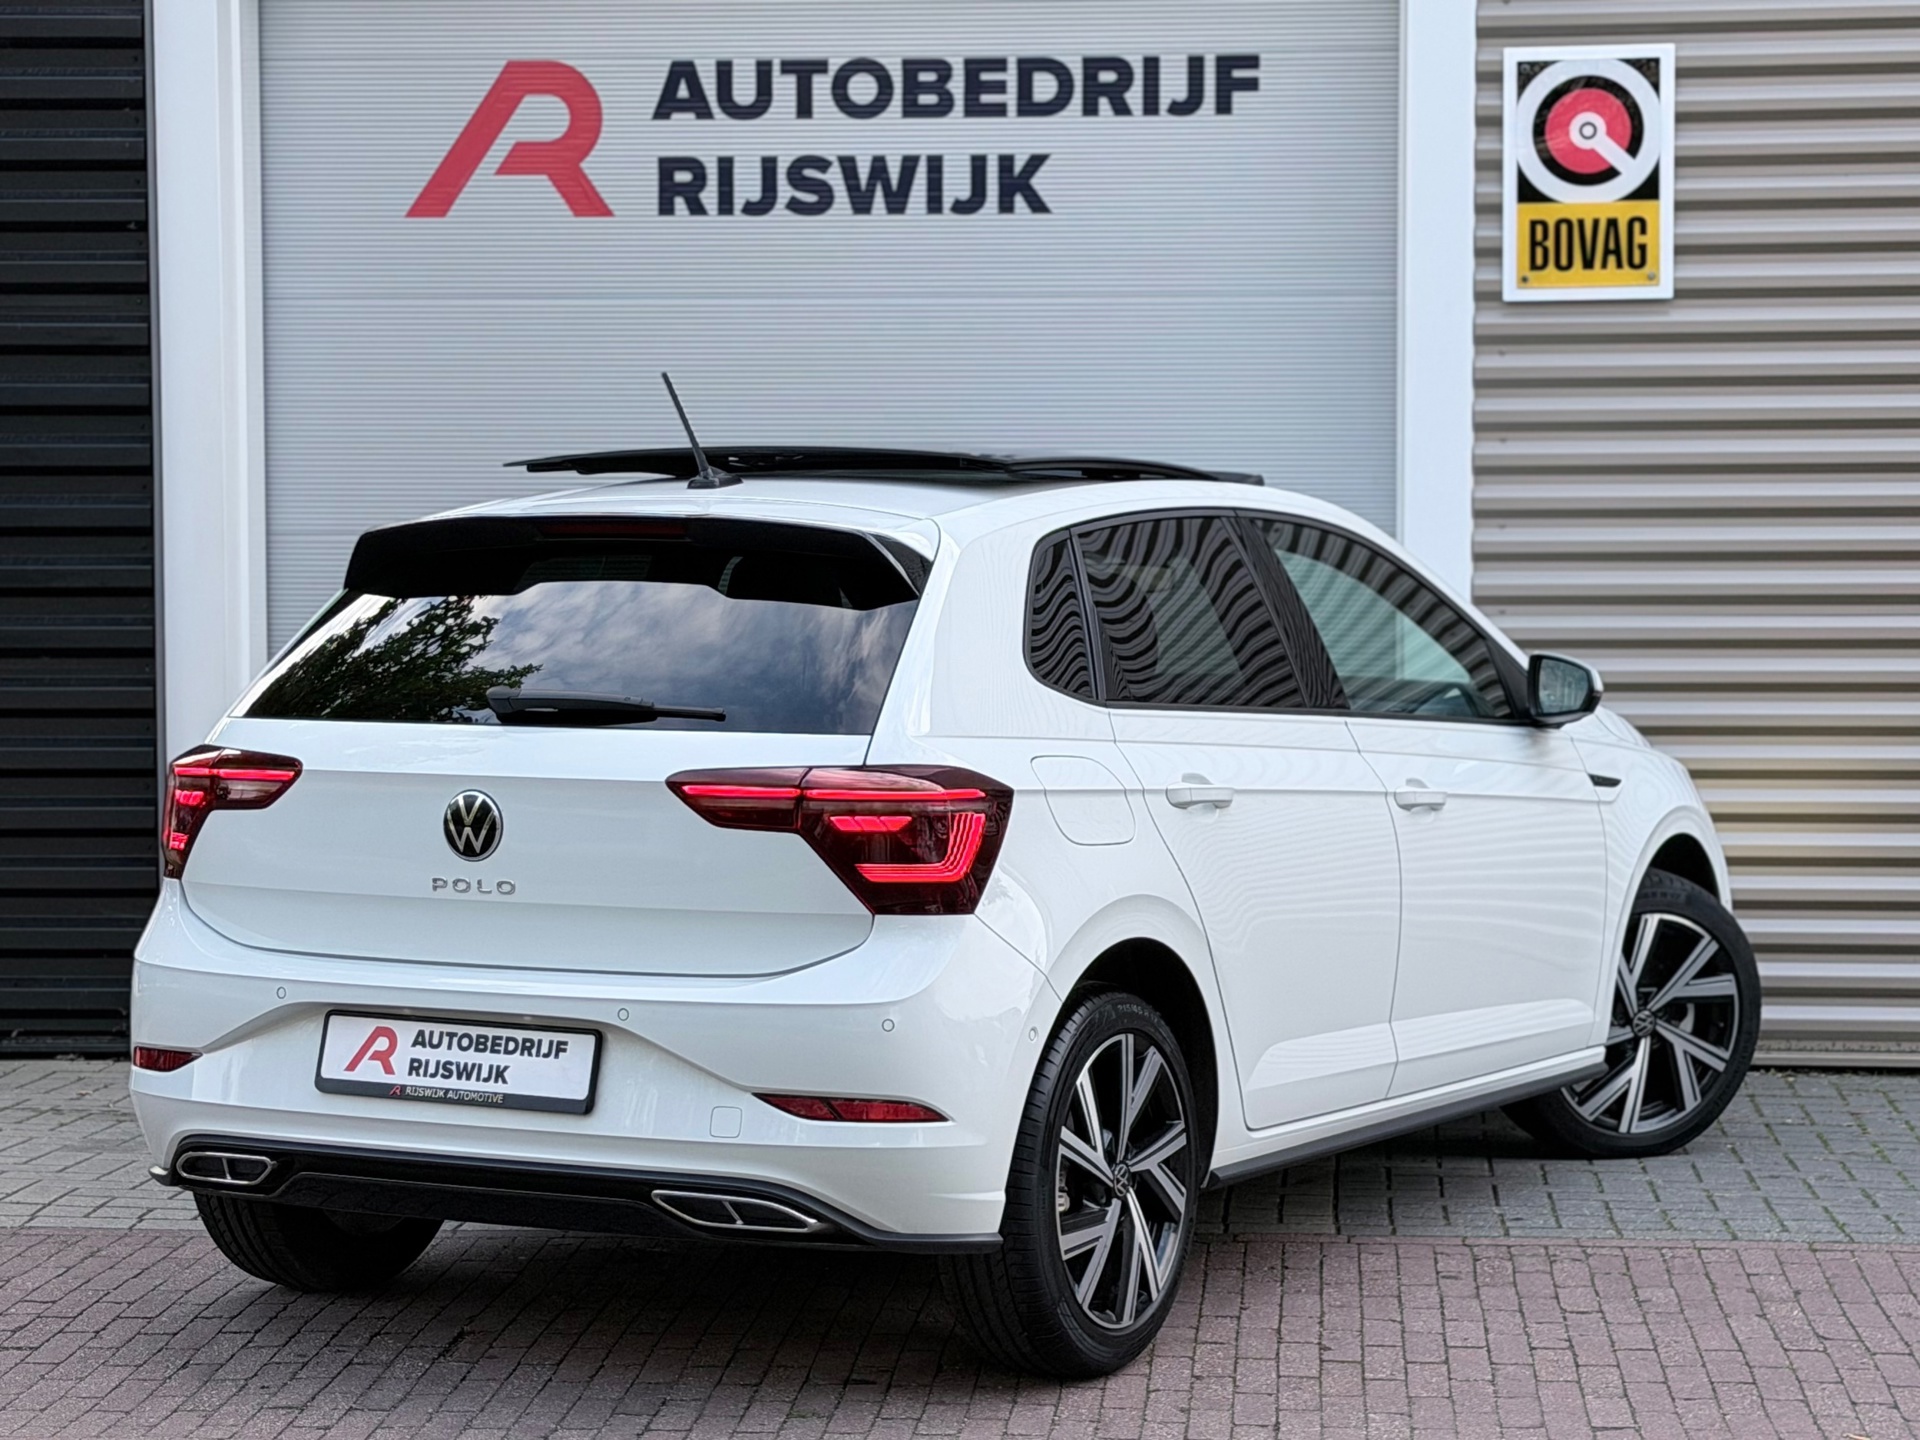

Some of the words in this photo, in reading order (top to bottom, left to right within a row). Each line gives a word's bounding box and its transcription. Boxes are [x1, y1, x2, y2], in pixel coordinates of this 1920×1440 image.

[652, 53, 1261, 120] AUTOBEDRIJF
[657, 153, 1053, 217] RIJSWIJK
[1529, 216, 1648, 272] BOVAG
[431, 876, 516, 896] POLO
[410, 1028, 569, 1060] AUTOBEDRIJF
[407, 1057, 511, 1085] RIJSWIJK
[405, 1086, 446, 1099] RIJSWIJK
[446, 1091, 505, 1104] AUTOMOTIVE
